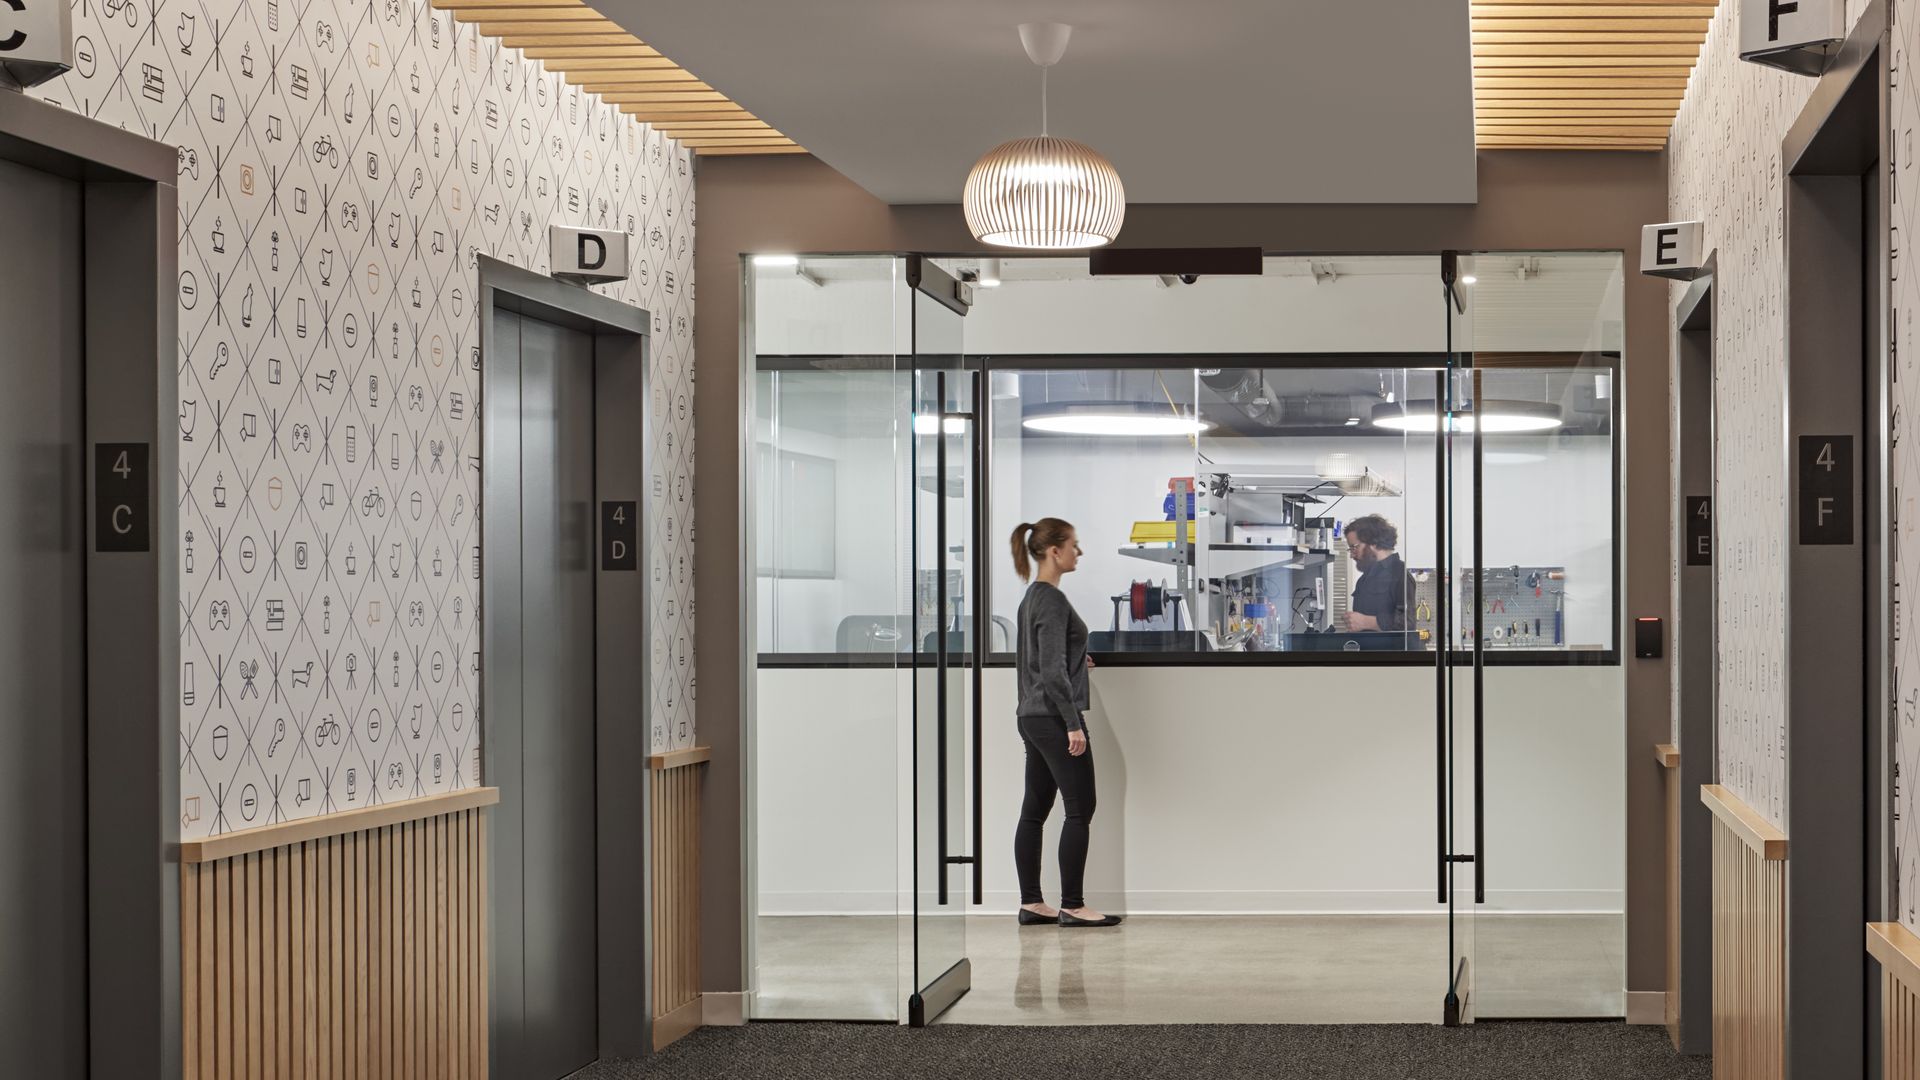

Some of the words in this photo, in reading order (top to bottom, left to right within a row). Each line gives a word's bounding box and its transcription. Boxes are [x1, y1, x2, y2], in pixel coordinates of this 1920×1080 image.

[578, 232, 607, 270] D
[1656, 228, 1678, 265] E
[112, 450, 132, 480] 4
[1816, 443, 1835, 472] 4
[112, 504, 132, 534] C
[612, 505, 626, 525] 4
[1697, 500, 1710, 520] 4
[1818, 497, 1834, 526] F
[612, 540, 626, 559] D
[1697, 535, 1710, 555] E
